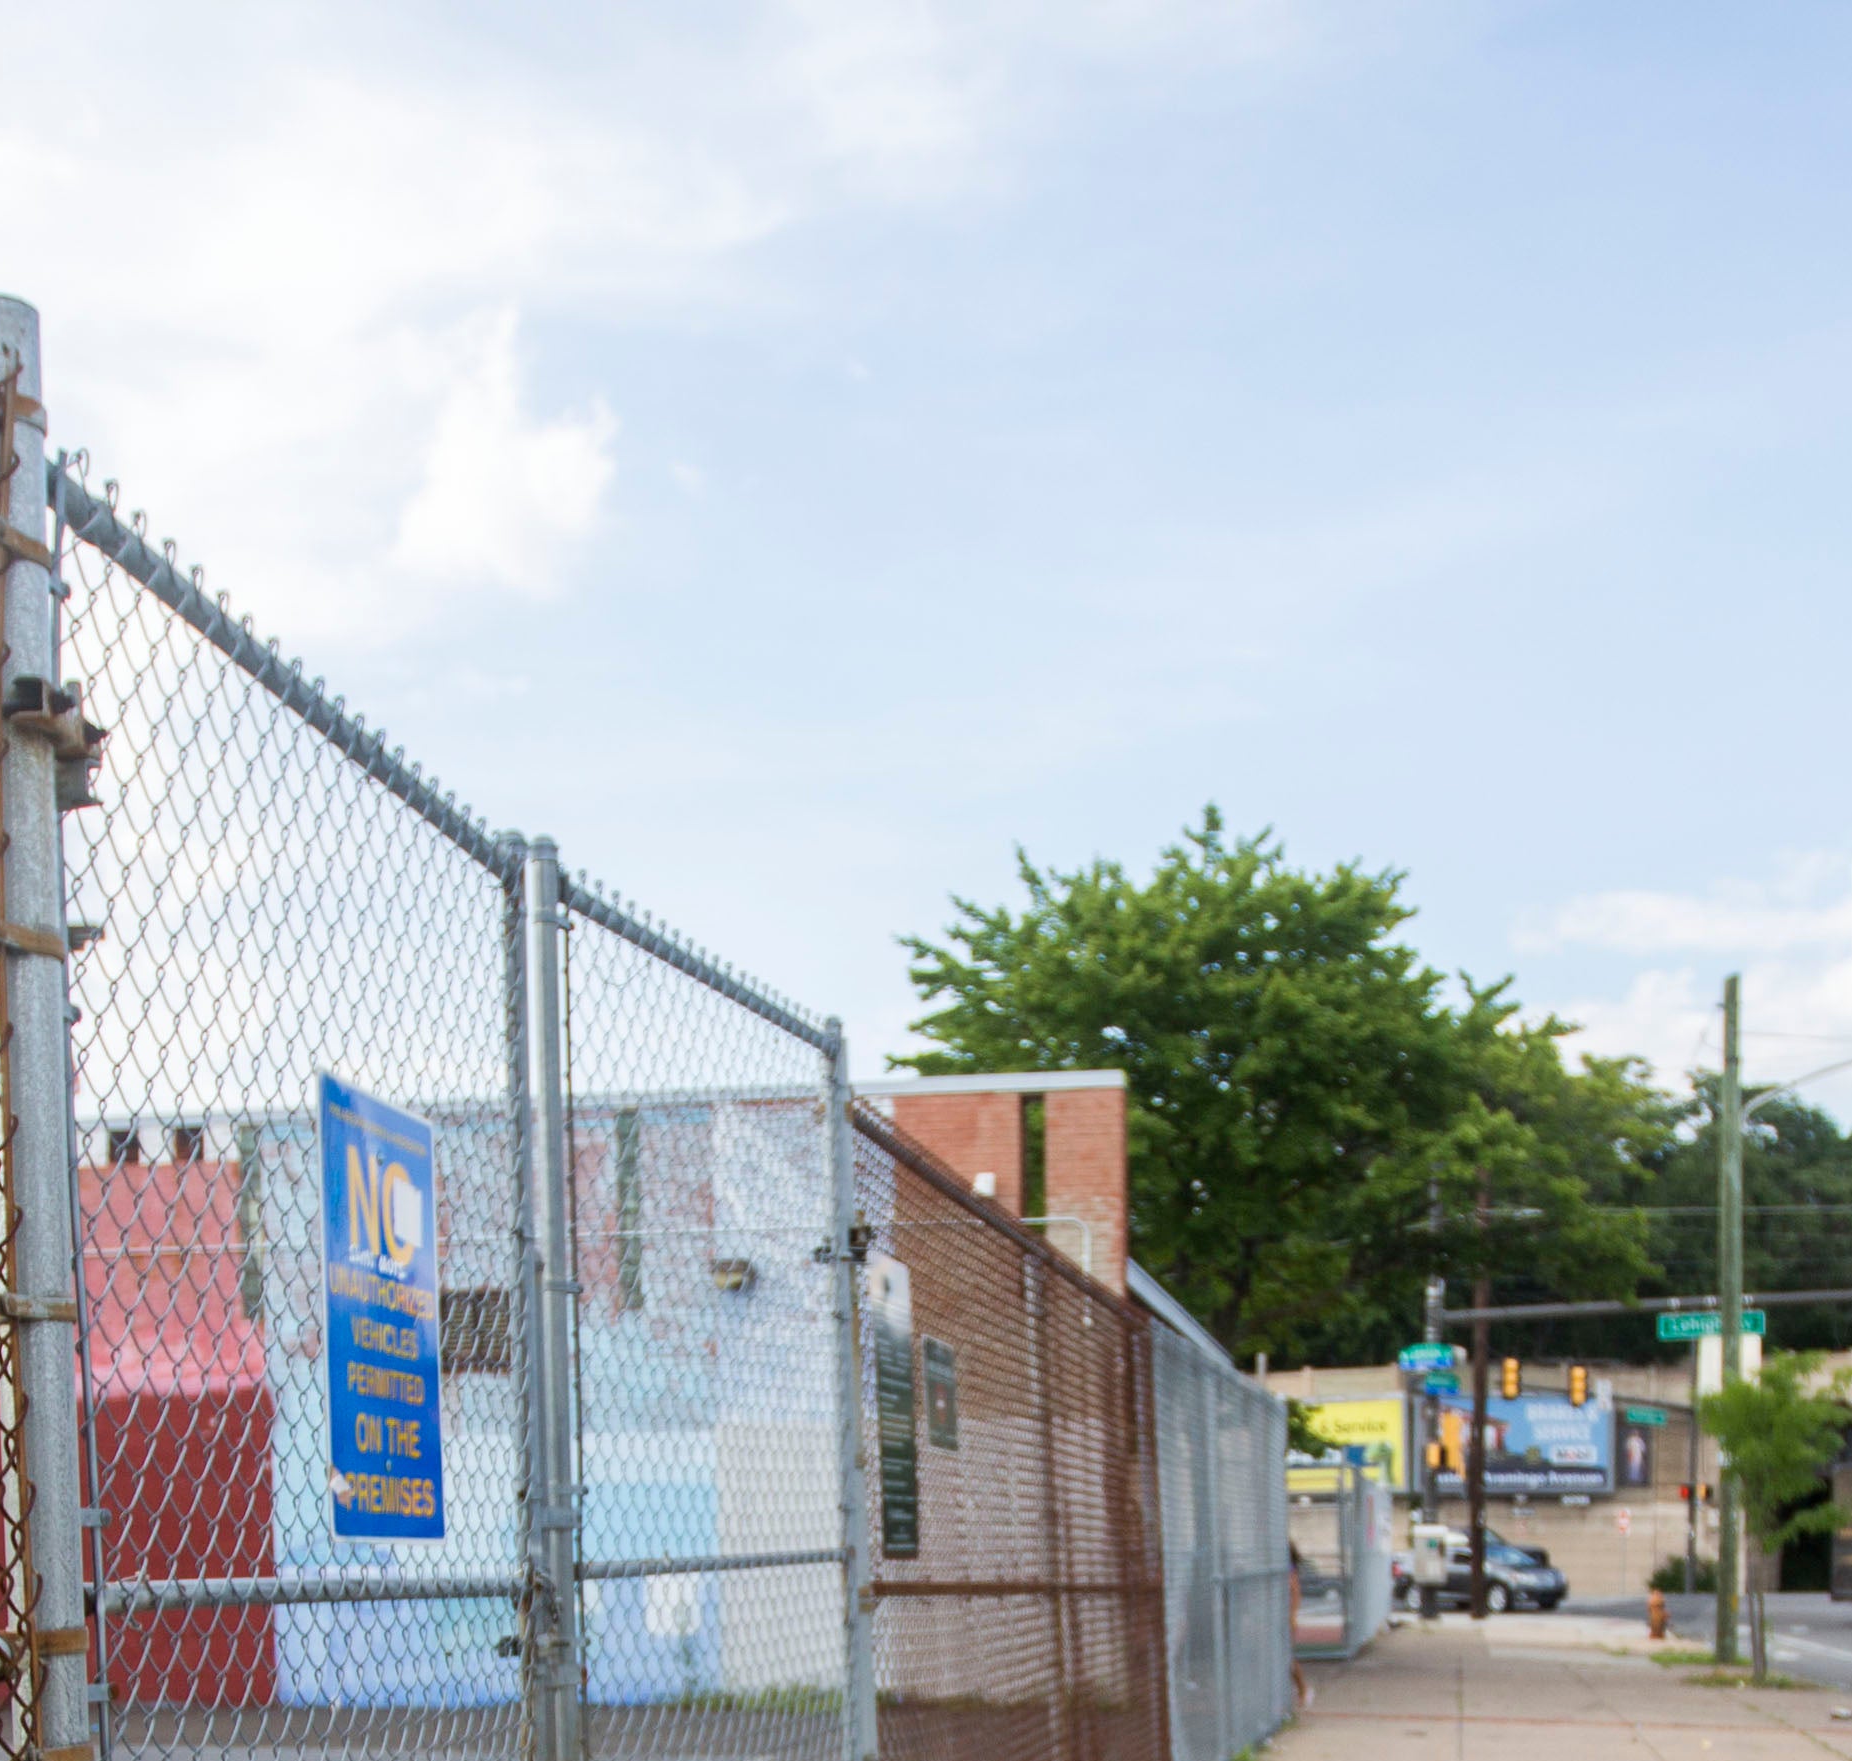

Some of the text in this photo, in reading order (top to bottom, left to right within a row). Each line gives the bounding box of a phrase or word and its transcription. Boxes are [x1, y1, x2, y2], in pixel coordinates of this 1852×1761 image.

[329, 1264, 434, 1319] UNAUTHORIZED
[350, 1314, 420, 1361] VEHICLES
[347, 1361, 425, 1405] PERMITTED
[354, 1412, 422, 1460] ON THE
[1334, 1416, 1388, 1434] Service
[345, 1472, 436, 1520] PREMISES
